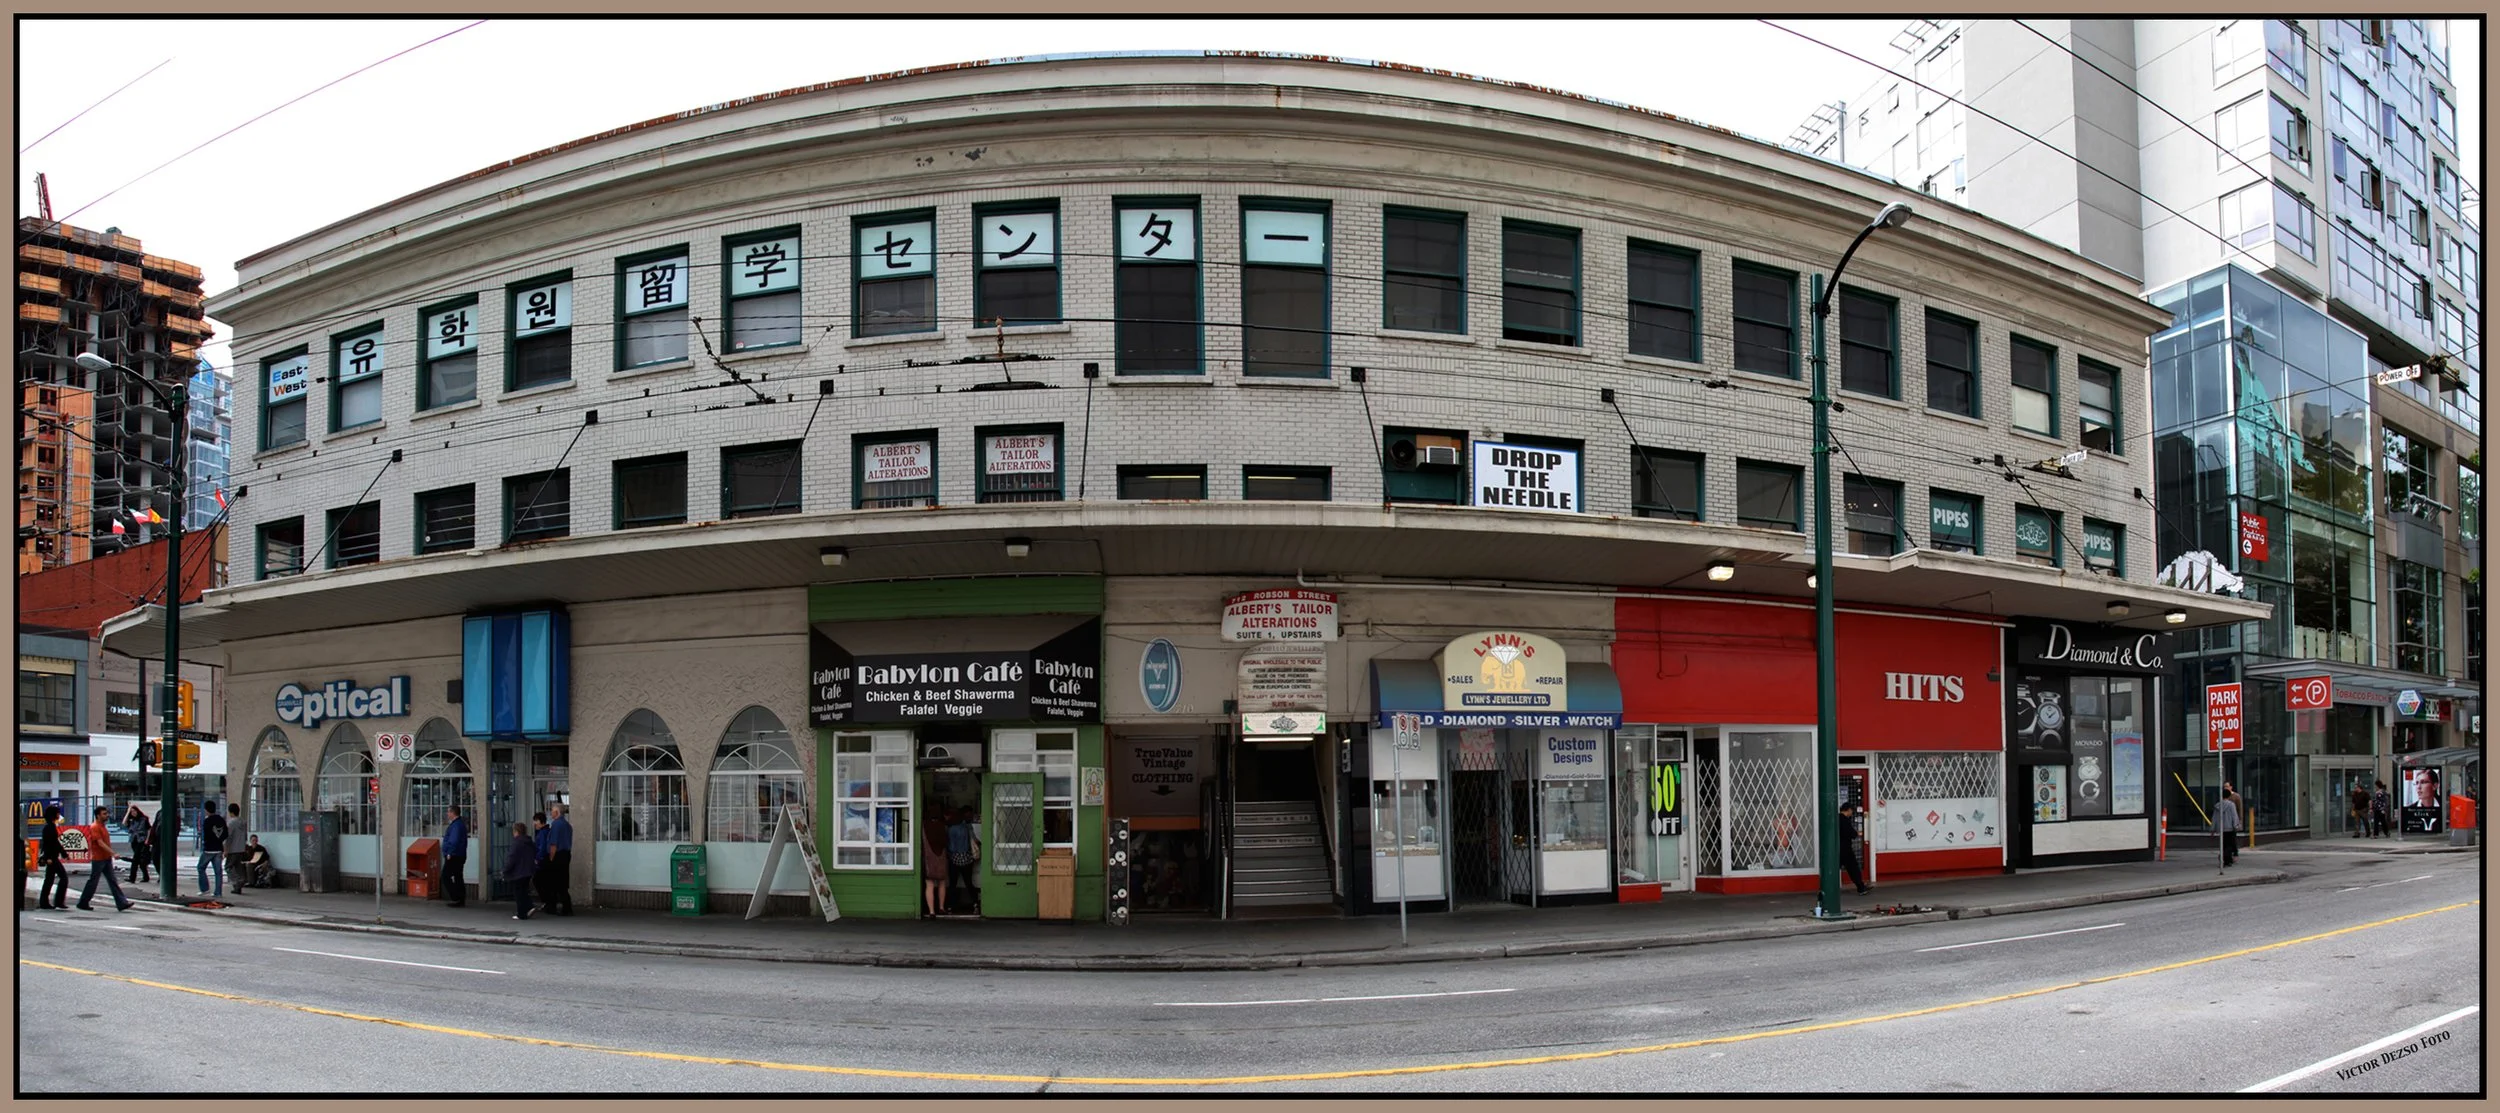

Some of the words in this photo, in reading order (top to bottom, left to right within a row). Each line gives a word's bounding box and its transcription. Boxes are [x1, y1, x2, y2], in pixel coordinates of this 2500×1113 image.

[272, 366, 309, 383] East-
[2379, 371, 2403, 382] POWER
[273, 378, 307, 397] West
[995, 437, 1045, 449] ALBERT'S
[873, 444, 921, 458] ALBERT'S
[1000, 450, 1039, 460] TAILOR
[878, 456, 916, 469] TAILOR
[989, 460, 1052, 472] ALTERATIONS
[1492, 448, 1561, 470] DROP
[867, 466, 929, 480] ALTERATIONS
[1504, 469, 1549, 489] THE
[1483, 486, 1571, 509] NEEDLE
[1933, 507, 1969, 528] PIPES
[2242, 515, 2260, 530] Public
[2084, 532, 2112, 551] PIPES
[2243, 527, 2265, 545] Parking
[1253, 590, 1290, 599] ROBSON
[1297, 591, 1331, 601] STREET
[1228, 603, 1282, 616] ALBERT'S
[1292, 603, 1332, 615] TAILOR
[1242, 617, 1317, 629] ALTERATIONS
[1236, 631, 1262, 639] SUITE
[1281, 631, 1322, 639] UPSTAIRS
[1473, 633, 1535, 658] LYNN'S
[2045, 623, 2119, 665] Diamond
[2120, 647, 2132, 666] &
[2135, 634, 2164, 669] Co.
[813, 667, 850, 685] Babylon
[858, 664, 960, 685] Babylon
[966, 661, 1023, 683] Café
[1035, 659, 1094, 679] Babylon
[821, 683, 842, 700] Café
[1049, 677, 1081, 695] Café
[1885, 672, 1964, 703] HITS
[2312, 685, 2322, 700] P
[277, 677, 401, 727] Optical
[865, 690, 910, 702] Chicken
[913, 690, 922, 701] &
[925, 689, 951, 701] Beef
[954, 689, 1015, 700] Shawerma
[1031, 696, 1052, 705] Chicken
[1058, 698, 1070, 706] Beef
[1070, 699, 1097, 708] Shawerma
[1466, 695, 1491, 704] LYNN'S
[1492, 695, 1532, 704] JEWELLERY
[1533, 696, 1549, 704] LTD.
[2210, 690, 2238, 706] PARK
[900, 704, 938, 716] Falafel
[944, 703, 983, 716] Veggie
[1066, 708, 1084, 717] Veggie
[2211, 708, 2223, 717] ALL
[2225, 706, 2238, 715] DAY
[2211, 718, 2239, 732] $10.00
[1548, 737, 1597, 751] Custom
[1141, 758, 1186, 770] Vintage
[1553, 752, 1593, 765] Designs
[1131, 773, 1194, 784] CLOTHING
[1650, 817, 1680, 835] OFF
